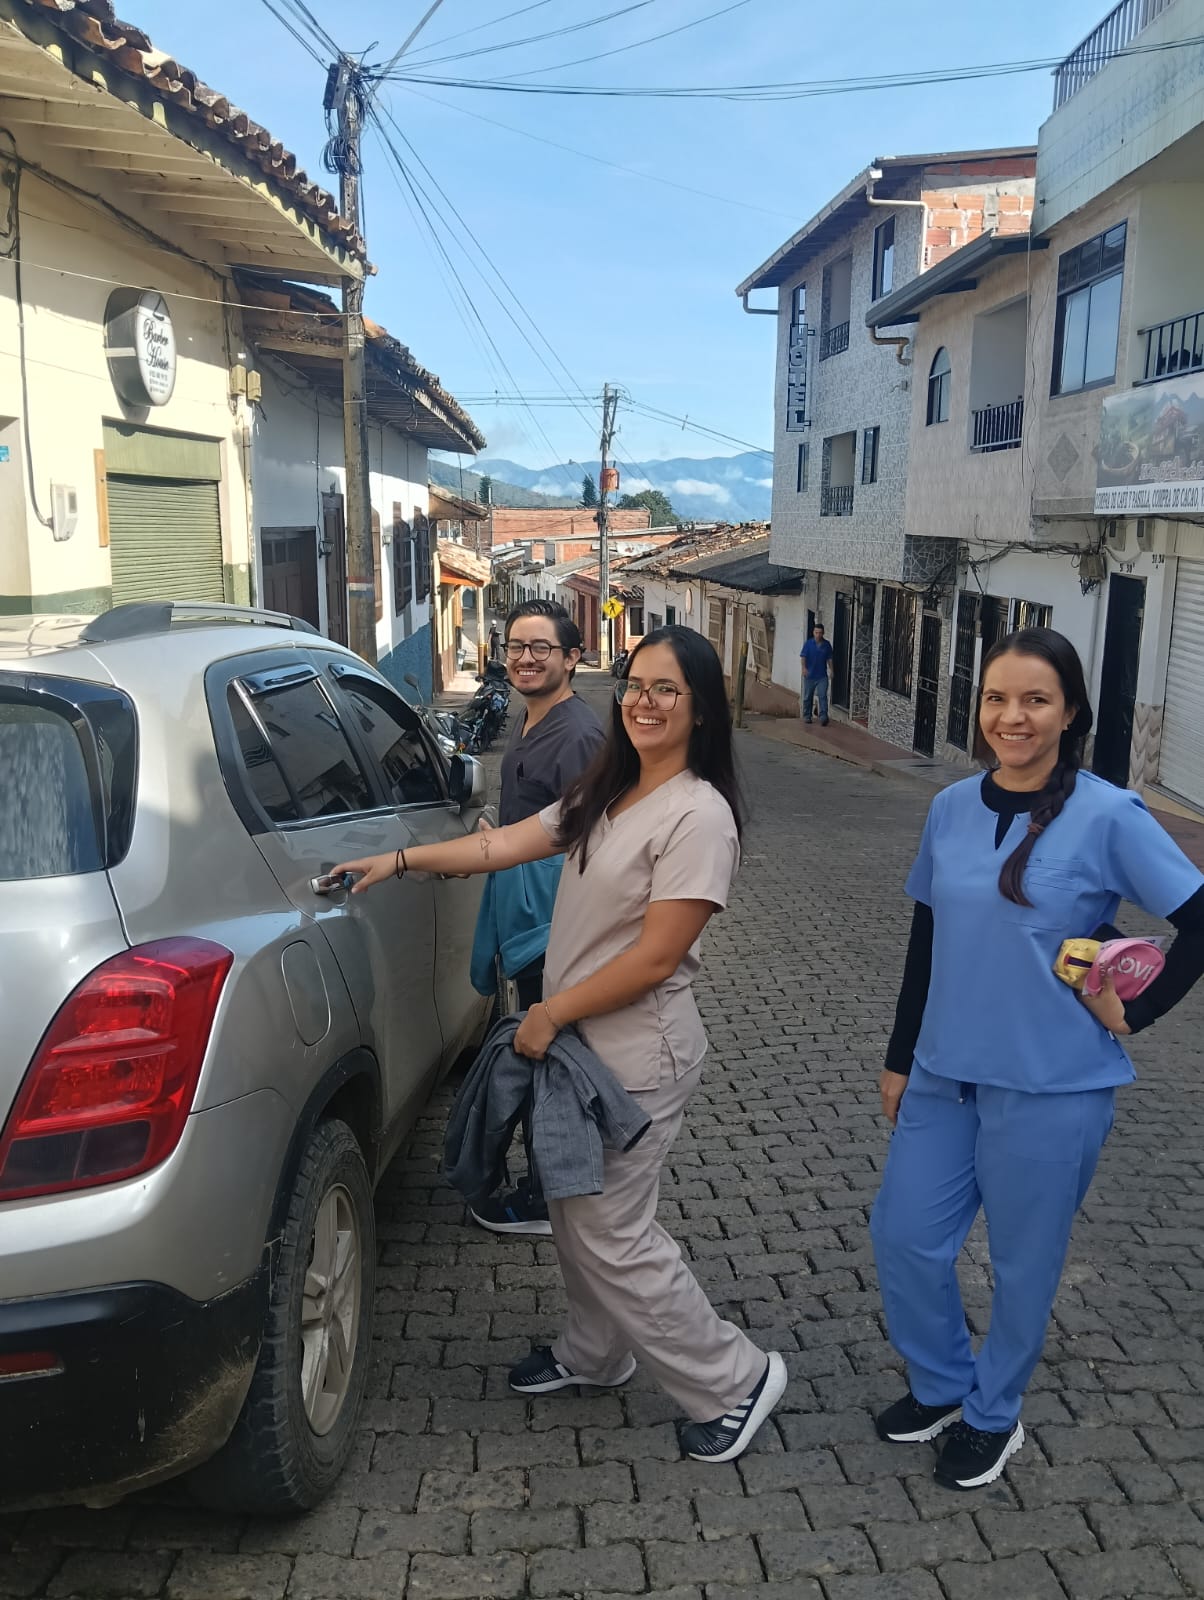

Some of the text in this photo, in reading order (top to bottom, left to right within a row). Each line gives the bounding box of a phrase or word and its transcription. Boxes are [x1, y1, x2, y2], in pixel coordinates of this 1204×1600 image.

[143, 318, 169, 346] Barber
[146, 343, 169, 371] House
[787, 324, 808, 431] HOTEL
[1152, 488, 1171, 508] COMPRA
[1172, 488, 1181, 507] DE
